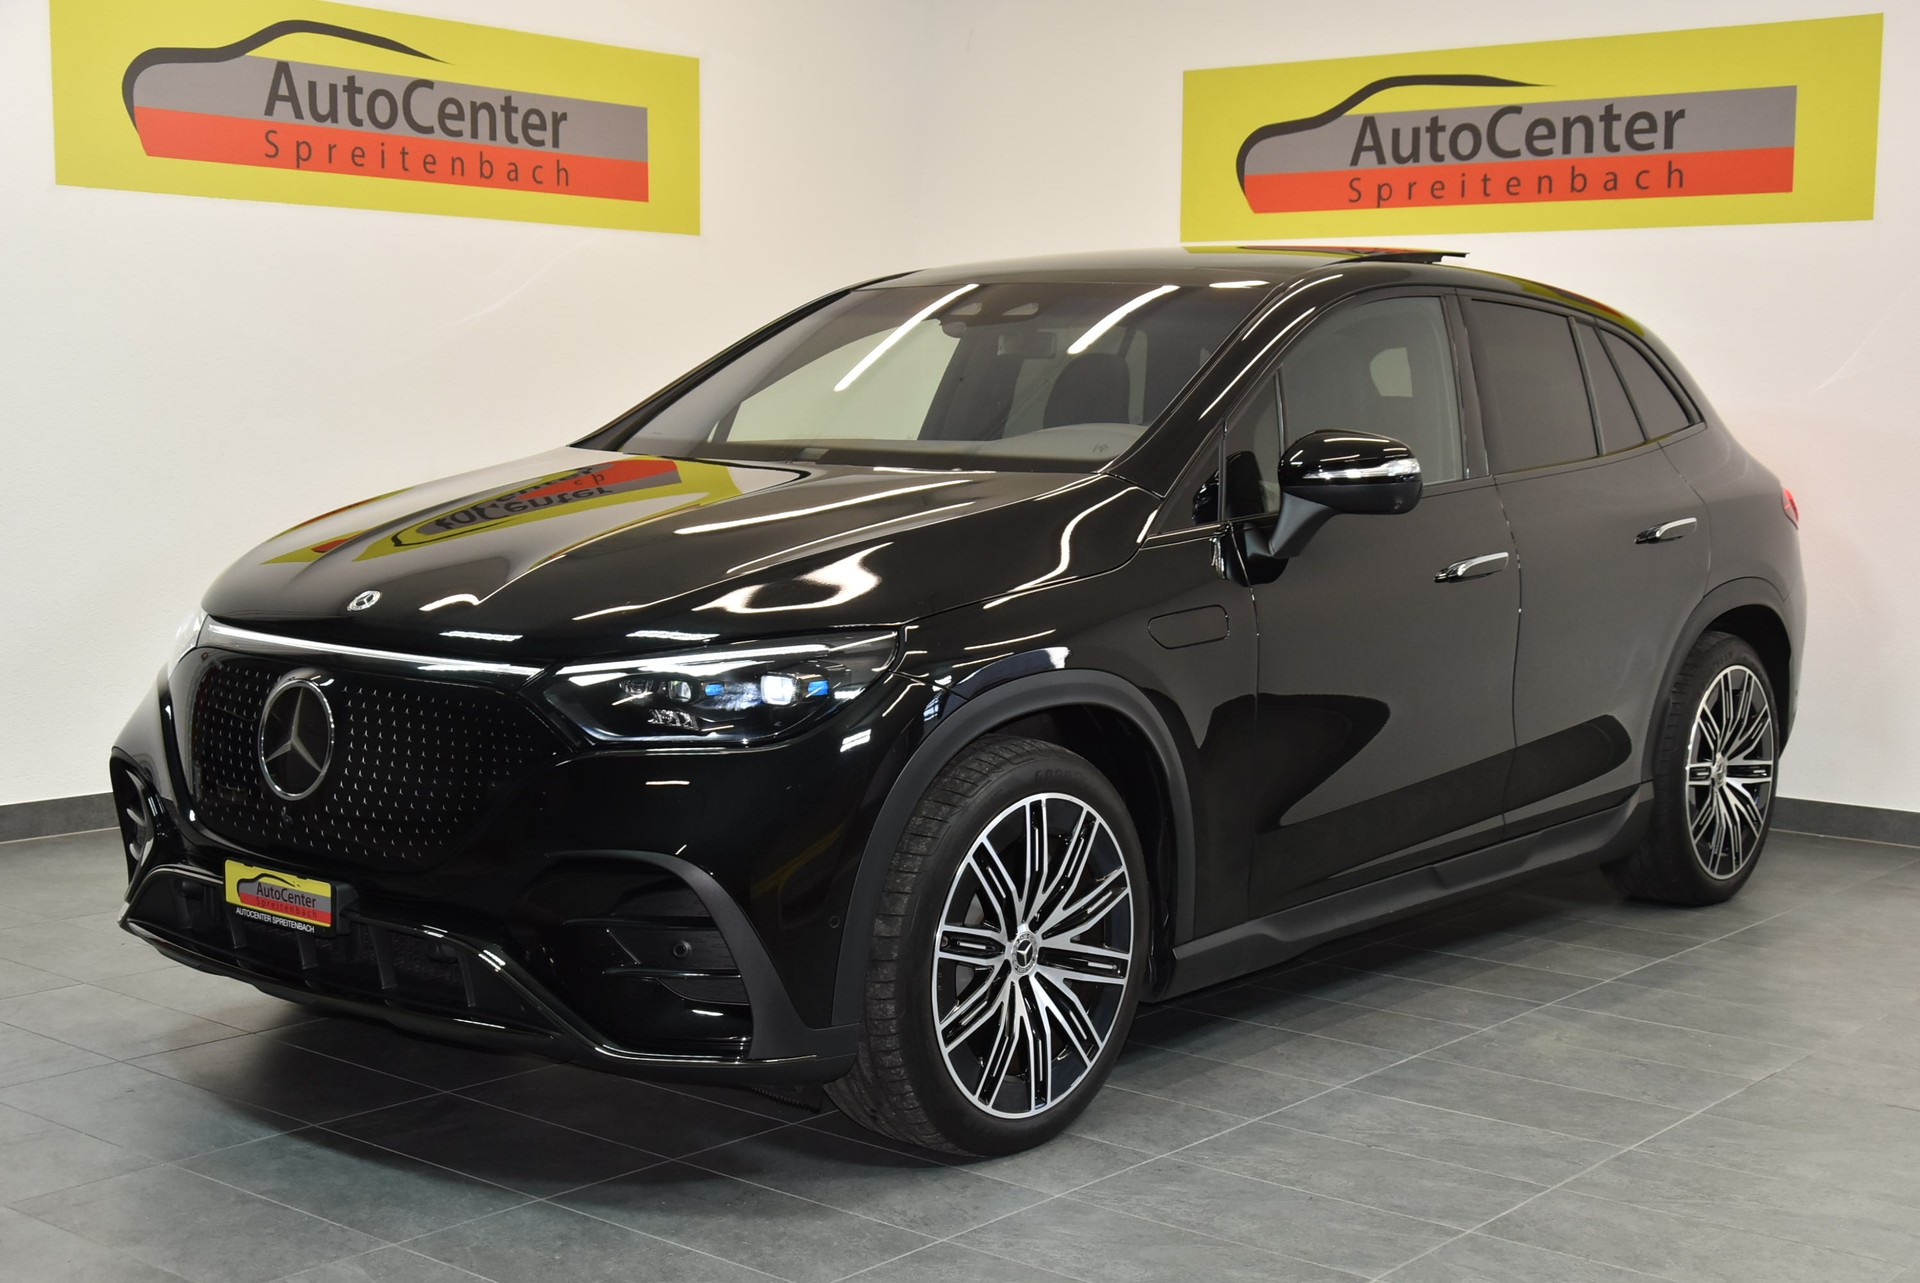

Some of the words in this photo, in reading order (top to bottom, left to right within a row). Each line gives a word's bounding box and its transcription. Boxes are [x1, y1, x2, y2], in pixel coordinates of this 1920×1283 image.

[263, 60, 568, 149] AutoCenter
[264, 129, 570, 188] Spreitenbach
[1349, 103, 1686, 167] AutoCenter
[1348, 160, 1685, 208] Spreitenbach
[255, 896, 318, 919] Spreitenbach
[256, 881, 317, 909] AutoCenter
[235, 907, 272, 924] AUTOCENTER
[272, 915, 315, 933] SPREITENBACH
